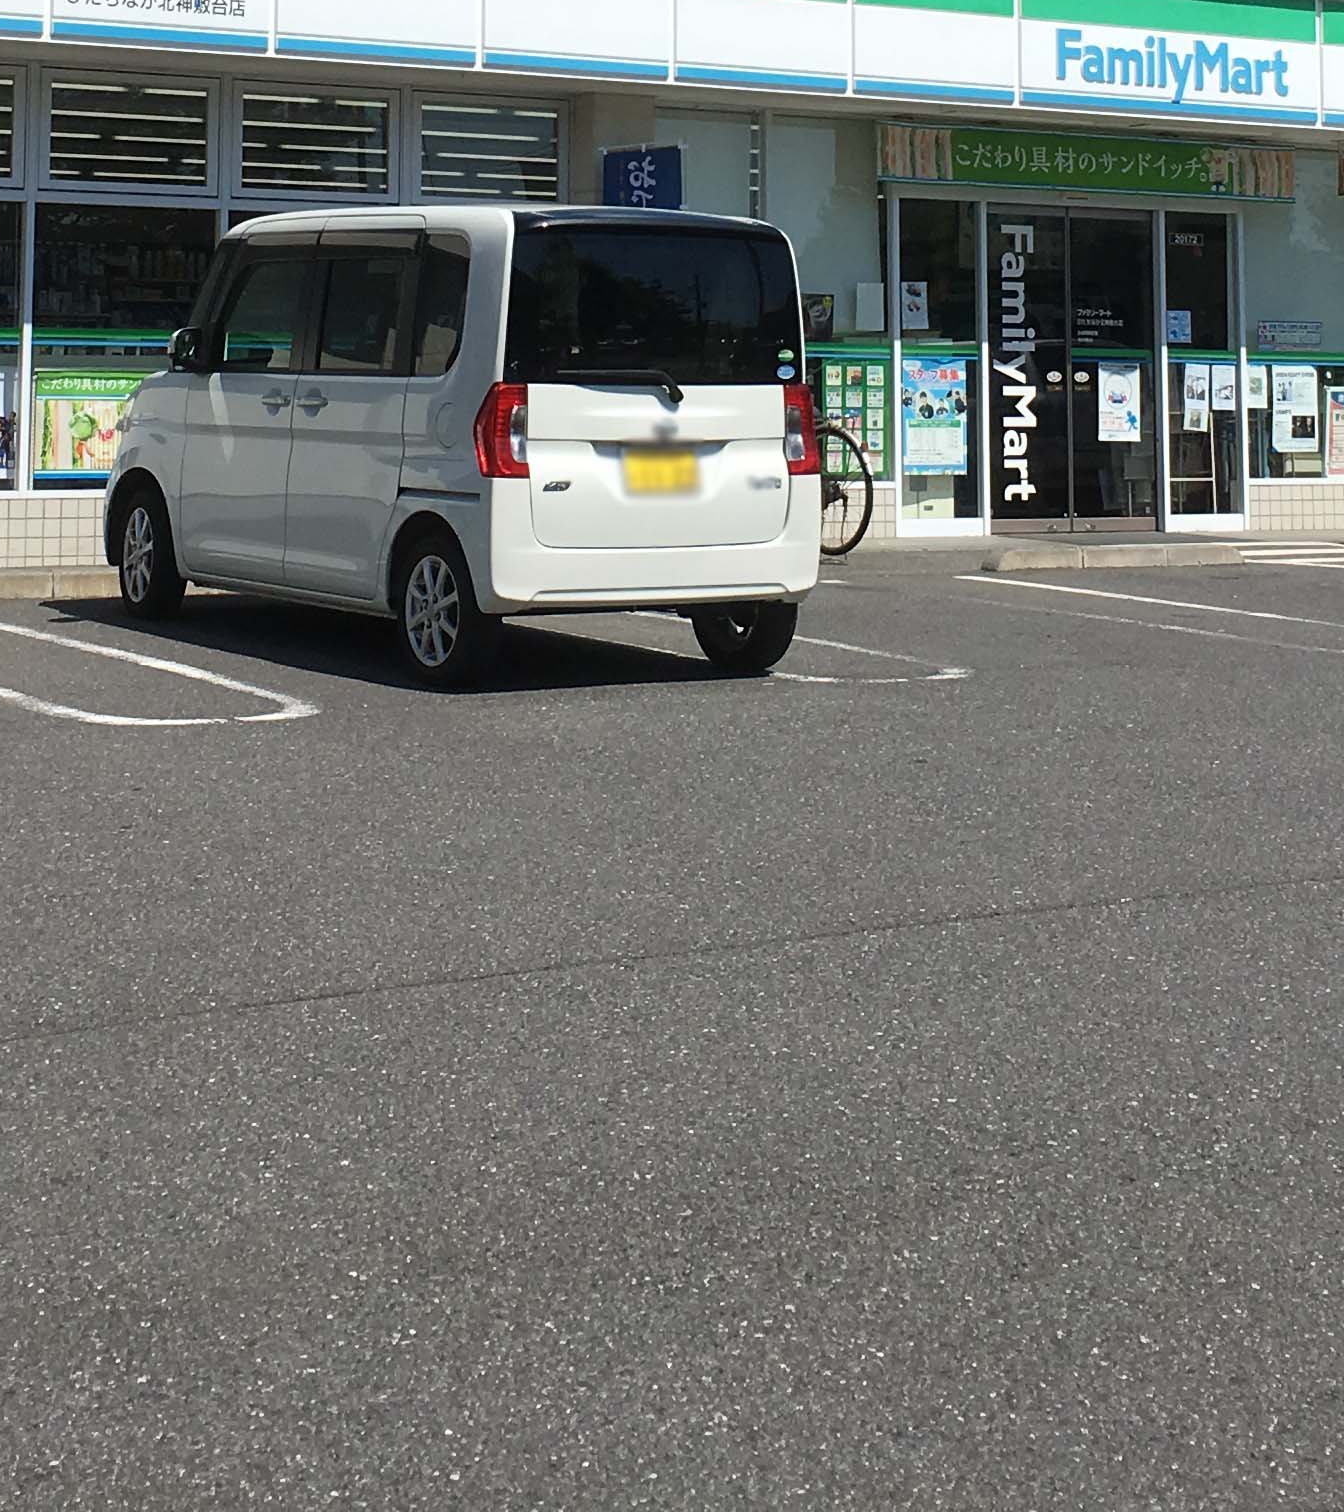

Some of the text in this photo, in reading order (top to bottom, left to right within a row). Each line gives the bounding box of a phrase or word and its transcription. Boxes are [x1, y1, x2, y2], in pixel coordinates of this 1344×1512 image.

[1056, 27, 1289, 105] FamilyMart
[956, 142, 1210, 183] こだわり具材のサンドイッチ。
[41, 377, 142, 390] こだわり具材のサン
[993, 224, 1037, 502] FamilyMart
